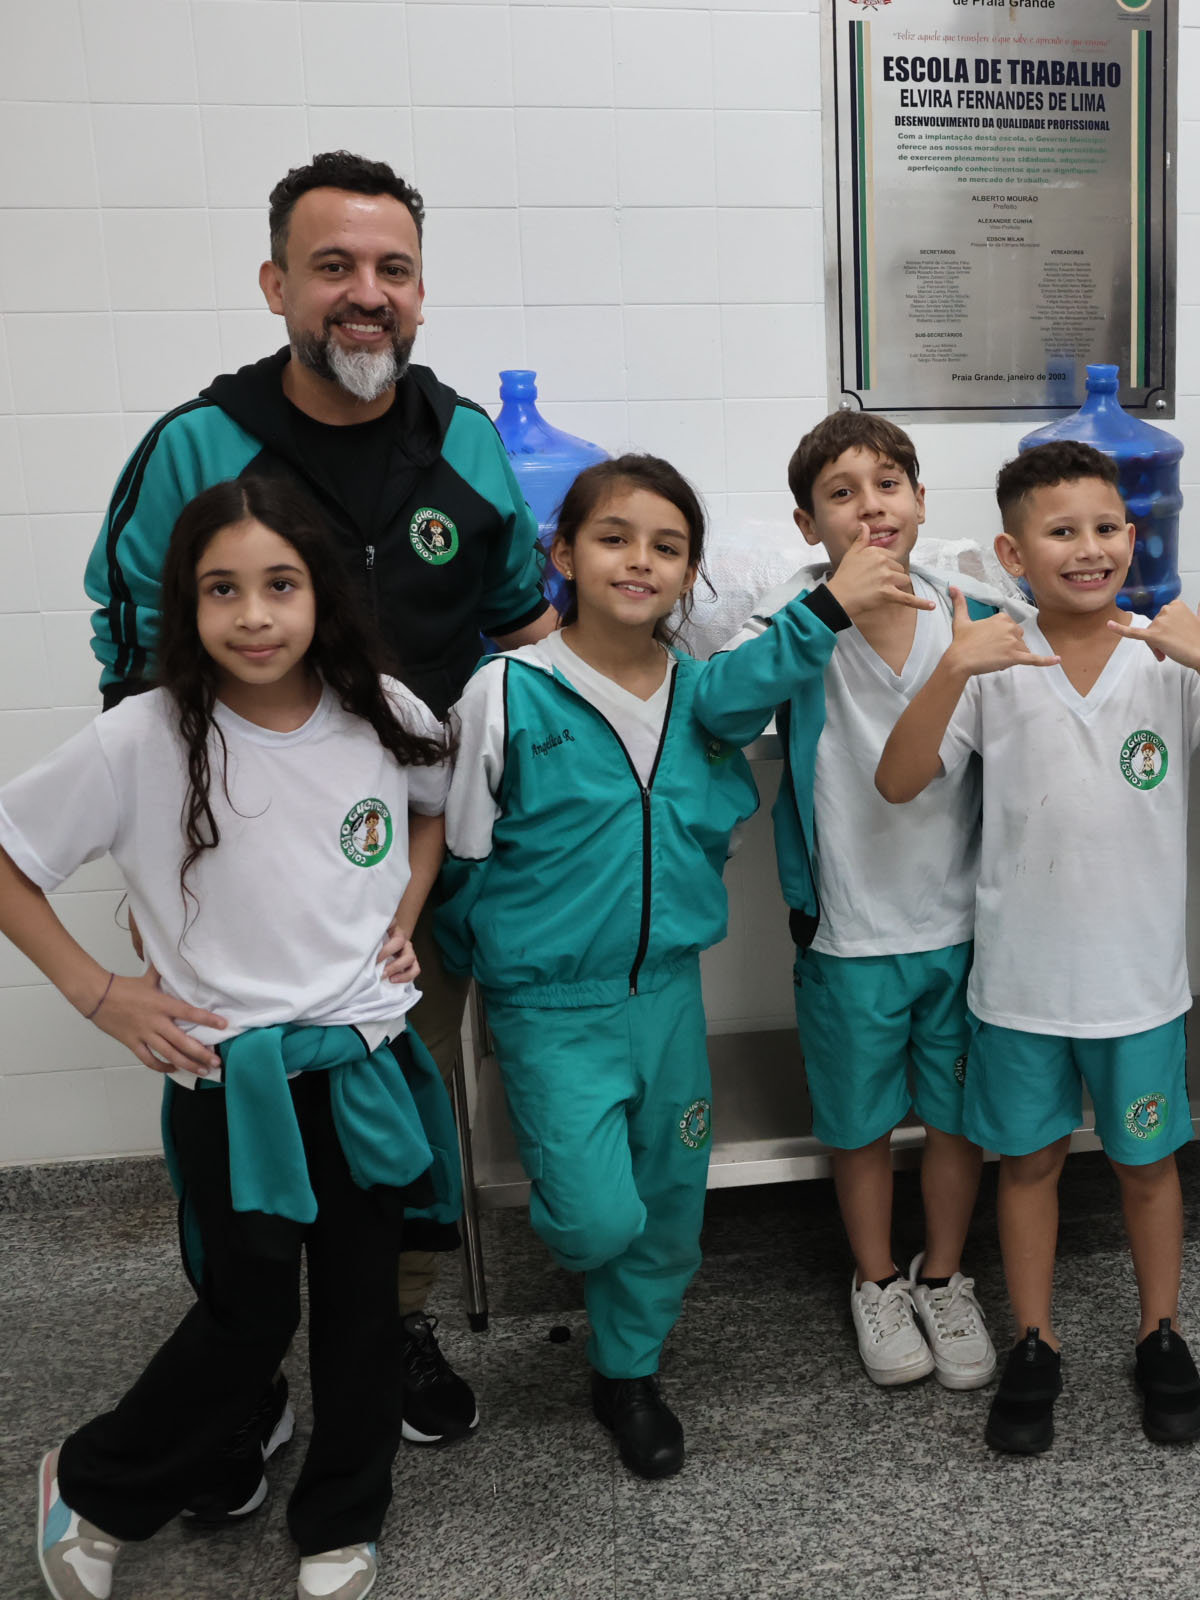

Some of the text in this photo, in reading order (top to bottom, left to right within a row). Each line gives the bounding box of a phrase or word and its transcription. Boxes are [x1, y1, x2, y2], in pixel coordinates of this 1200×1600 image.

[1009, 0, 1055, 9] Grande
[883, 56, 1121, 88] ESCOLA DE TRABALHO
[900, 88, 1106, 113] ELVIRA FERNANDES DE LIMA
[895, 115, 1110, 131] DESENVOLVIMENTO DA QUALIDADE PROFISSIONAL
[925, 133, 973, 142] implantação
[975, 134, 997, 142] desta
[897, 143, 927, 151] oferece
[907, 164, 963, 173] aperfeiçoando
[952, 373, 1067, 383] Praia Grande, janeiro de 2003
